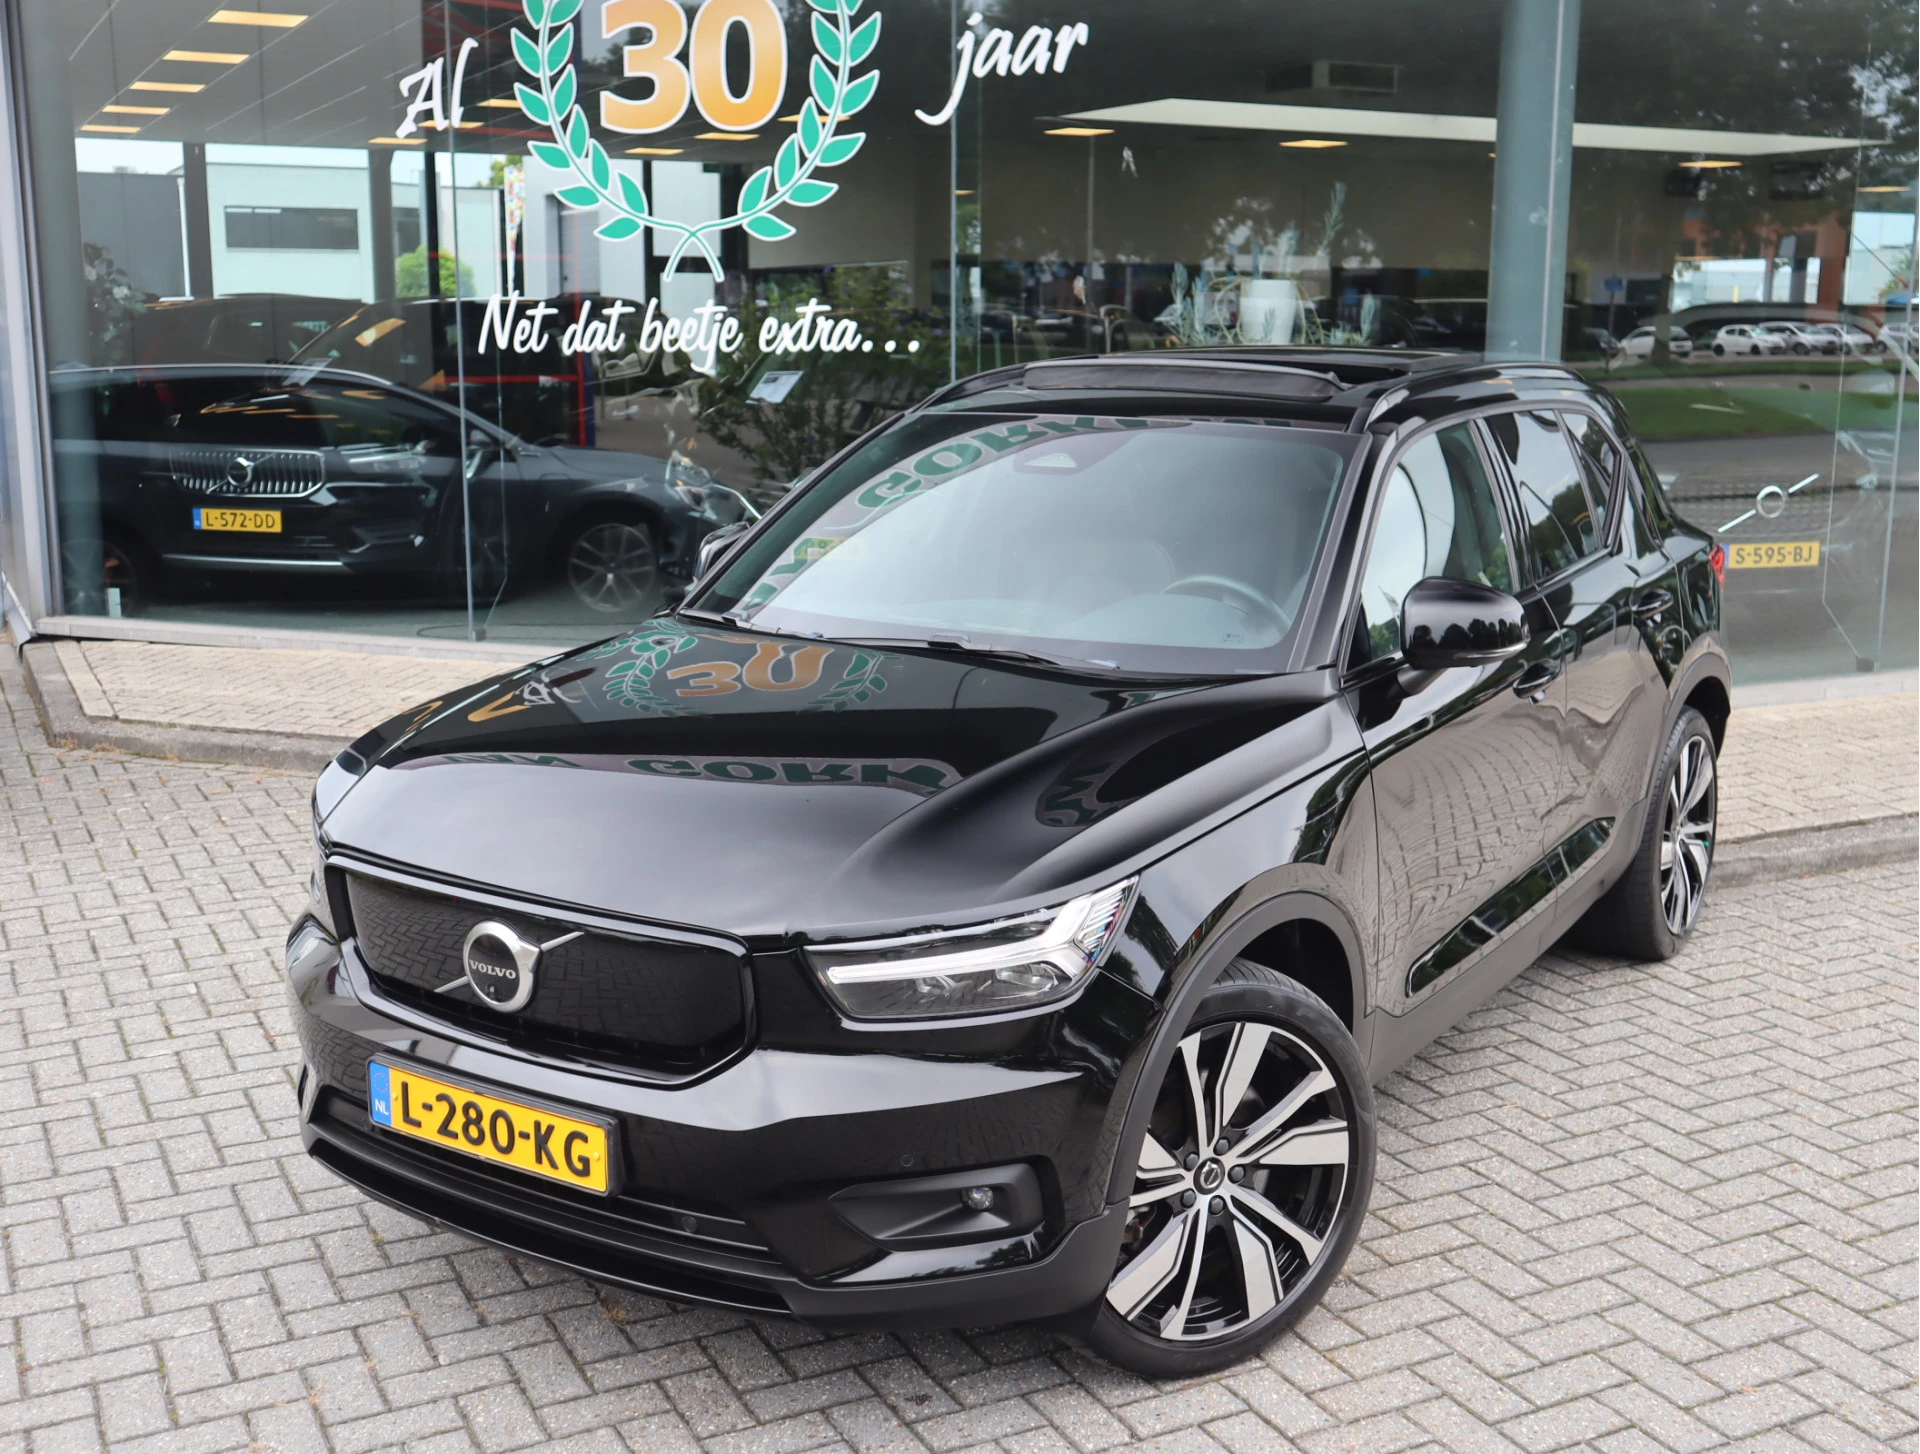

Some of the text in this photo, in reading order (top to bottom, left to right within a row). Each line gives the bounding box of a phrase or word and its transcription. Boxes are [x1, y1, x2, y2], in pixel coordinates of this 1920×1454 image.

[396, 0, 1089, 139] Al 30 jaar
[478, 290, 920, 376] Net dat beetje extra...
[205, 511, 276, 529] L-572-DD
[1735, 545, 1813, 565] S-595-BJ
[469, 960, 517, 979] VOLVO
[374, 1100, 389, 1116] NL
[401, 1080, 591, 1177] L-280-KG
